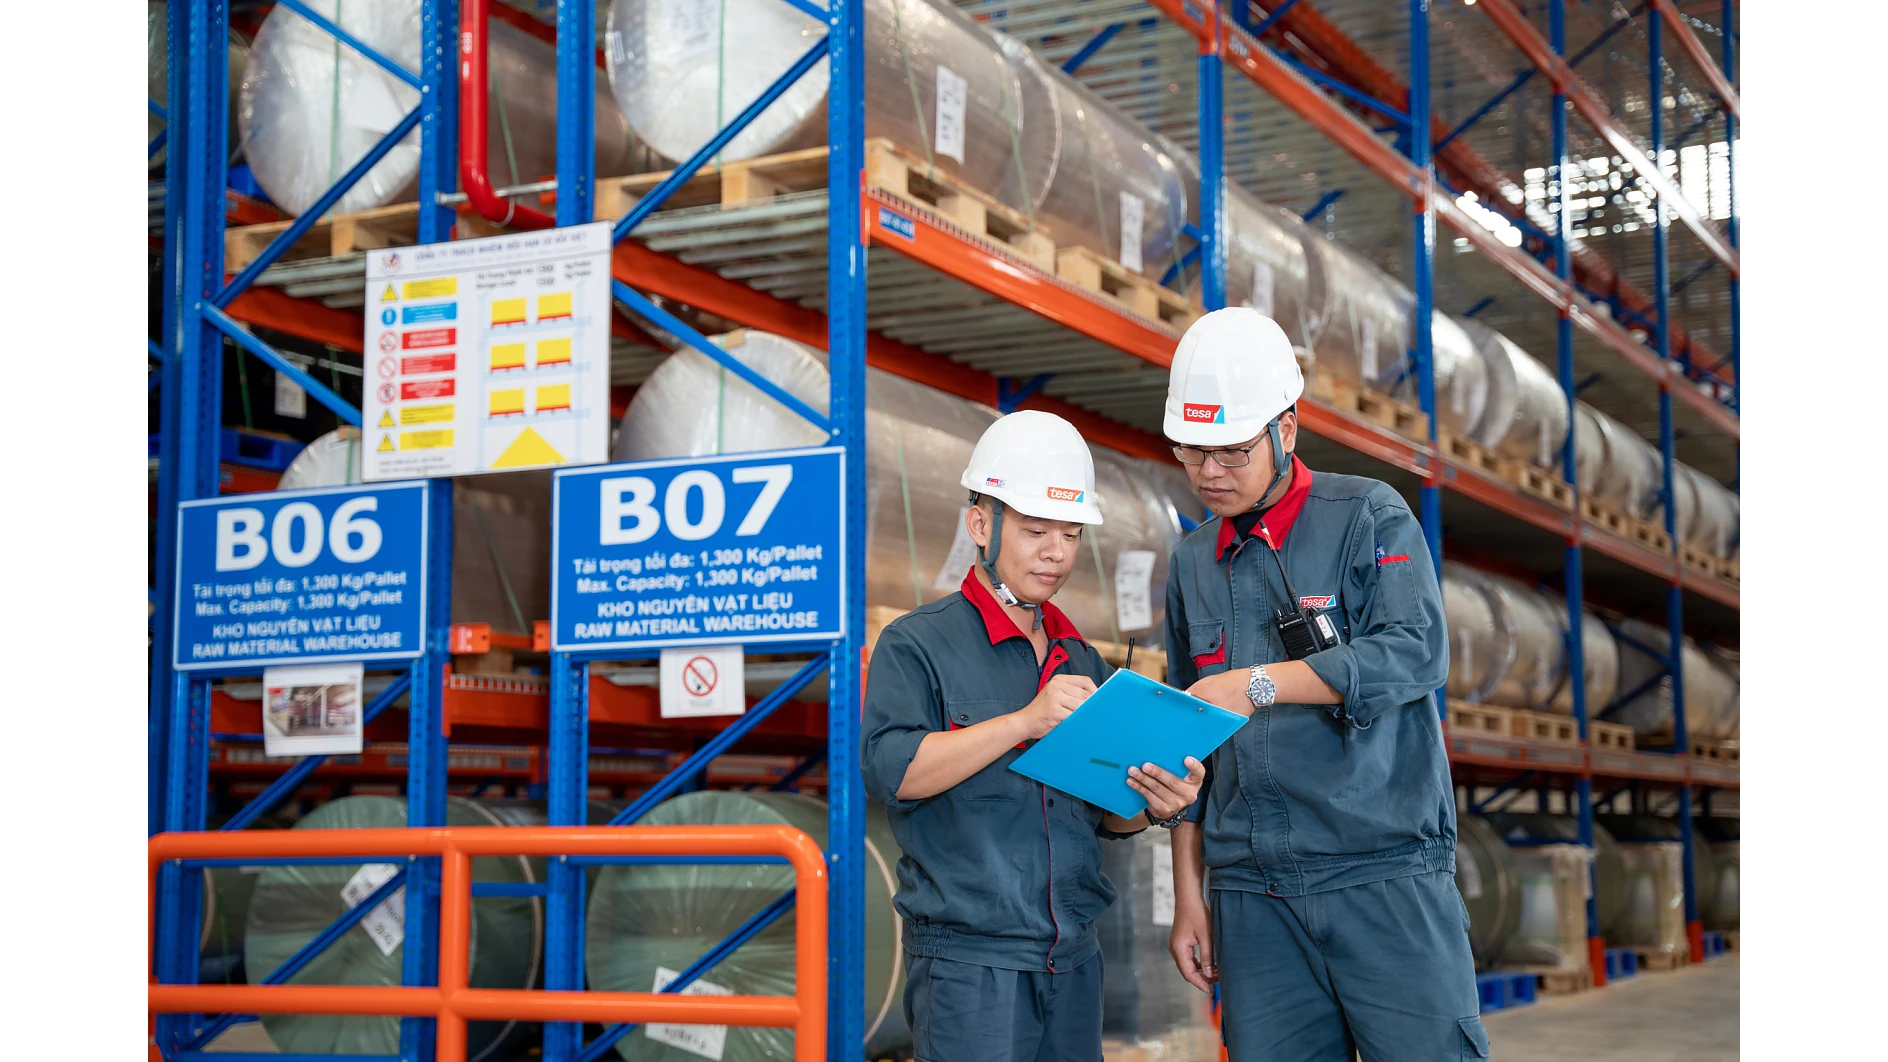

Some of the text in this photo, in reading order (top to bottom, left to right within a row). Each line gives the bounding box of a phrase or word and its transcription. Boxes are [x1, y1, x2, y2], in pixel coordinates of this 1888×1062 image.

[1186, 407, 1211, 419] tesa
[600, 464, 793, 545] B07
[1050, 489, 1074, 500] tesa
[215, 496, 382, 572] B06
[600, 558, 642, 575] trọng
[645, 552, 667, 571] tối
[699, 548, 743, 567] 1,300
[746, 545, 822, 567] Kg/Pallet
[341, 571, 406, 592] Kg/Pallet
[576, 565, 817, 594] Max. Capacity: 1,300 Kg/Pallet
[337, 591, 402, 611] Kg/Pallet
[598, 592, 793, 618] KHO NGUYÊN VẬT LIỆU
[1303, 598, 1325, 608] tesa
[213, 623, 244, 638] KHO
[248, 617, 309, 637] NGUYÊN
[574, 611, 818, 639] RAW MATERIAL WAREHOUSE
[193, 632, 402, 658] RAW MATERIAL WAREHOUSE
